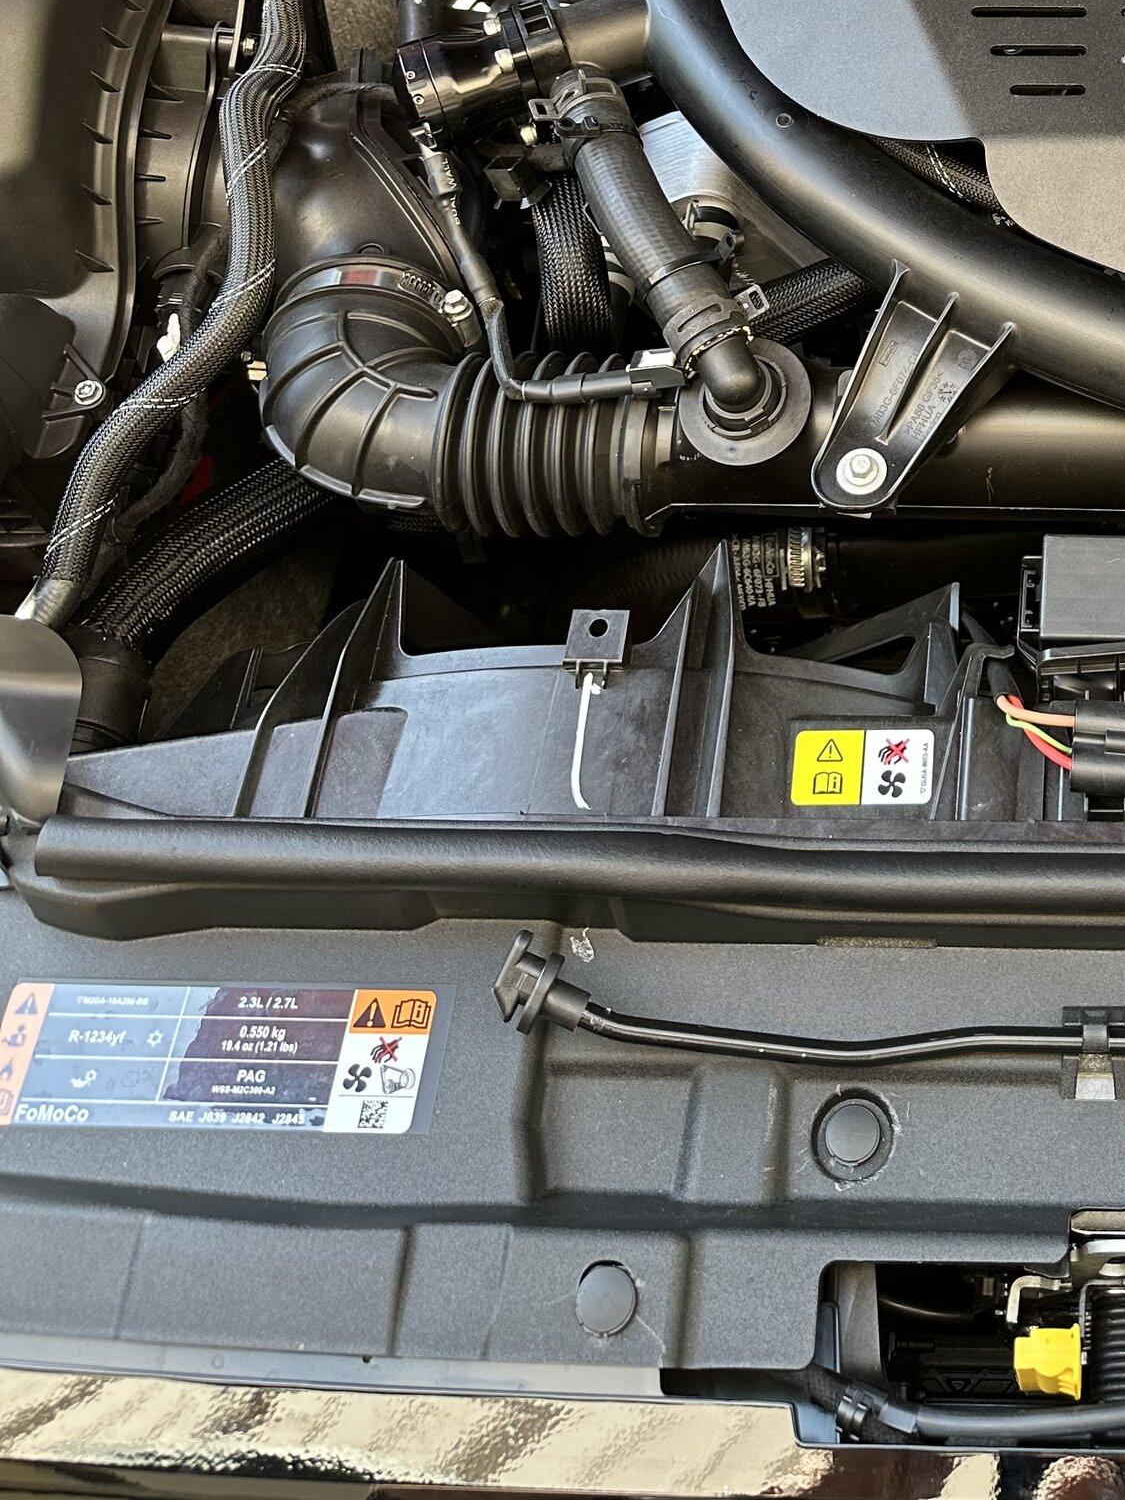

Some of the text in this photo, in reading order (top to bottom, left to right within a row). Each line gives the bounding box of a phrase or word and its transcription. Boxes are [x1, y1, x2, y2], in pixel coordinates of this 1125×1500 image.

[238, 996, 263, 1008] 2.3L
[272, 997, 298, 1009] 2.7L
[68, 1029, 127, 1046] R-1234yf
[239, 1025, 286, 1041] 0.550 kg
[241, 1042, 254, 1051] oz
[236, 1069, 266, 1082] PAG
[14, 1104, 90, 1122] FoMoCo
[168, 1110, 195, 1123] SAE
[198, 1111, 227, 1124] J639
[231, 1112, 265, 1124] J2842
